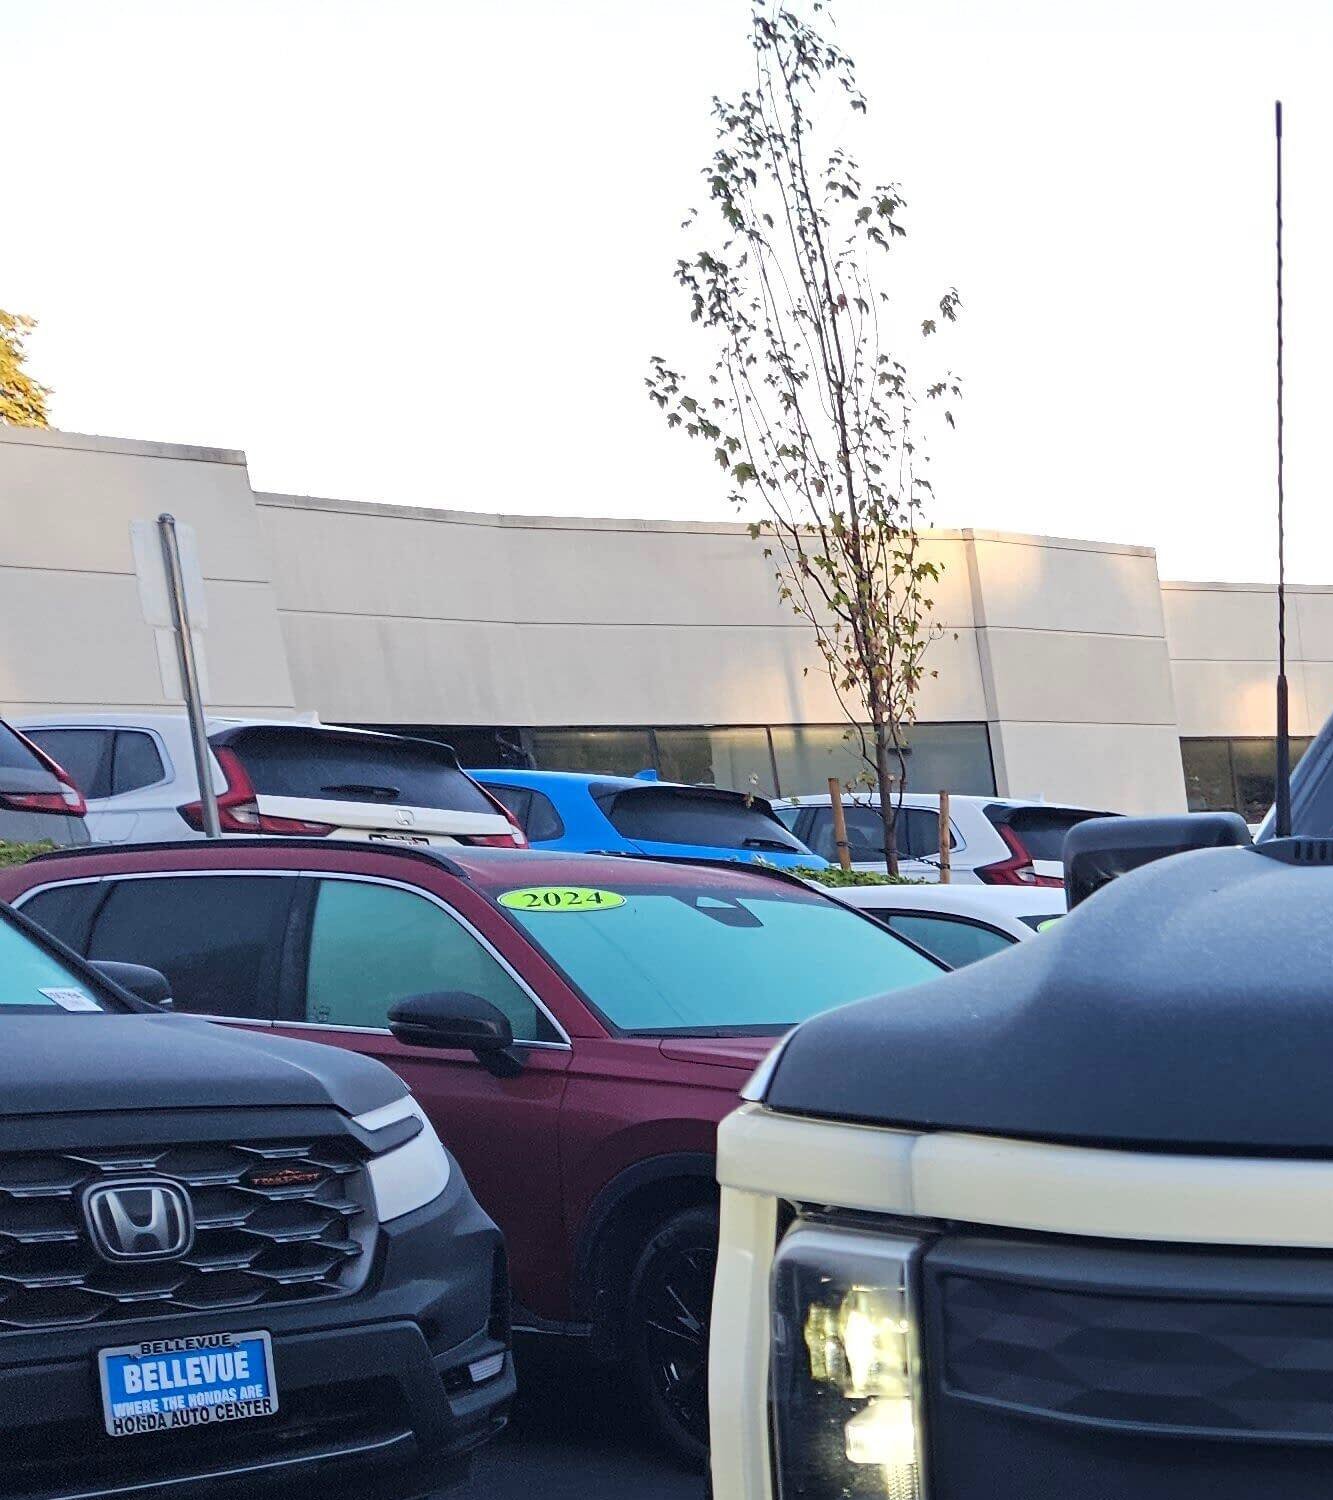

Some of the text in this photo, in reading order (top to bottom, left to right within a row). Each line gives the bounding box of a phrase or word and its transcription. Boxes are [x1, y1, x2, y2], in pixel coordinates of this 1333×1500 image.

[522, 891, 604, 907] 2024
[140, 1334, 232, 1355] BELLEVUE
[123, 1351, 250, 1394] BELLEVUE
[113, 1384, 264, 1418] WHERE THE HONDAS ARE
[113, 1398, 273, 1435] HONDA AUTO CENTER
